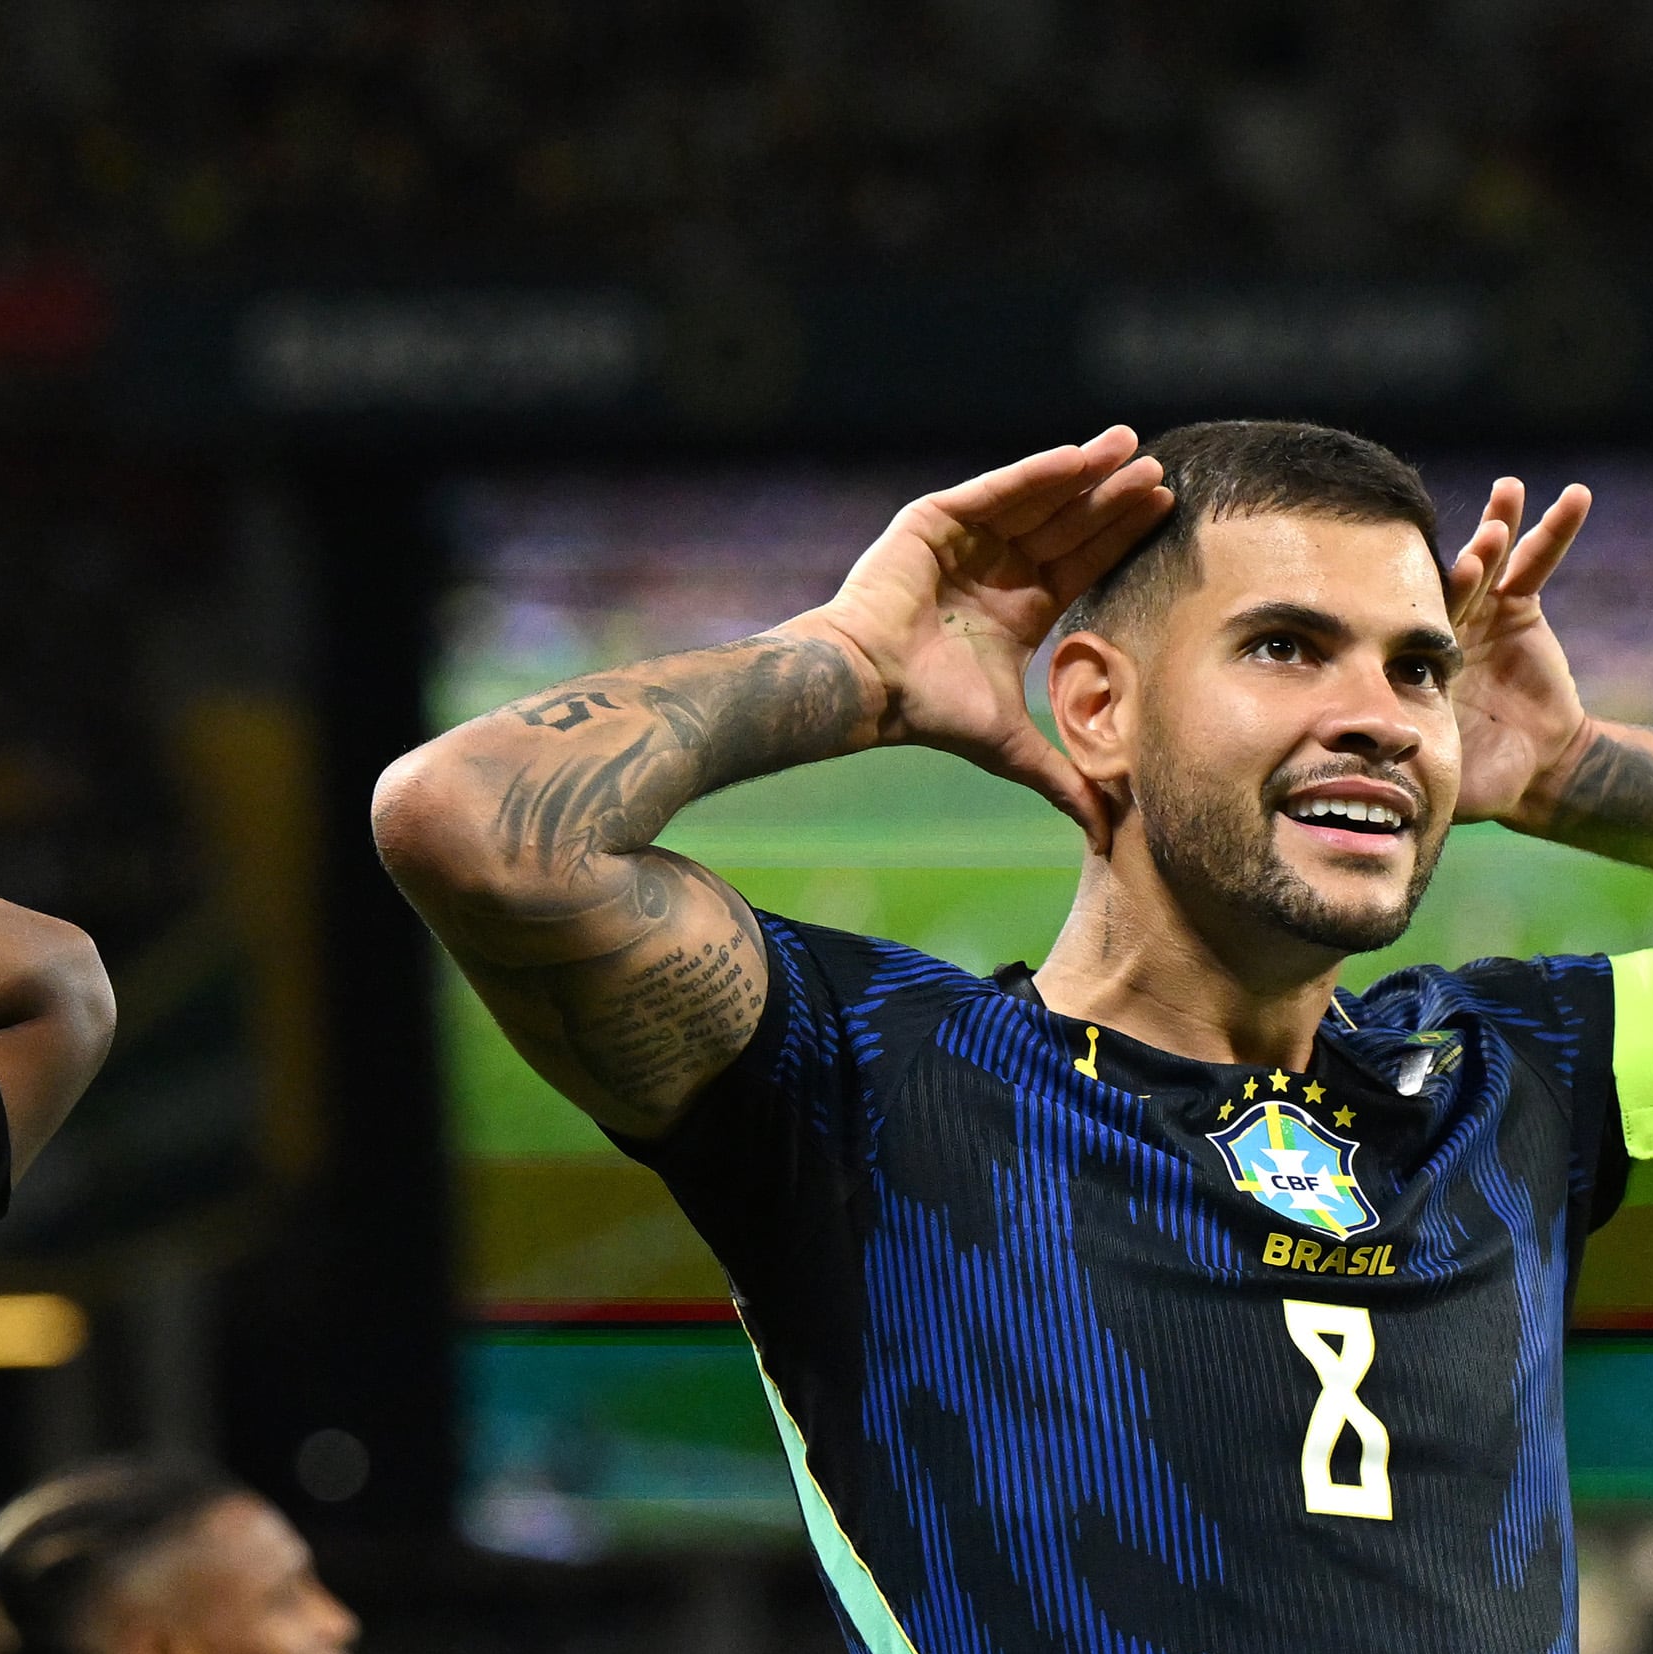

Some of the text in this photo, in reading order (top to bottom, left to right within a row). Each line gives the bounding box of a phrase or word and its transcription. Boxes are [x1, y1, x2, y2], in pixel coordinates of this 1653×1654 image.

[1271, 1174, 1320, 1192] CBF
[1262, 1232, 1397, 1276] BRASIL
[1282, 1298, 1393, 1521] 8
